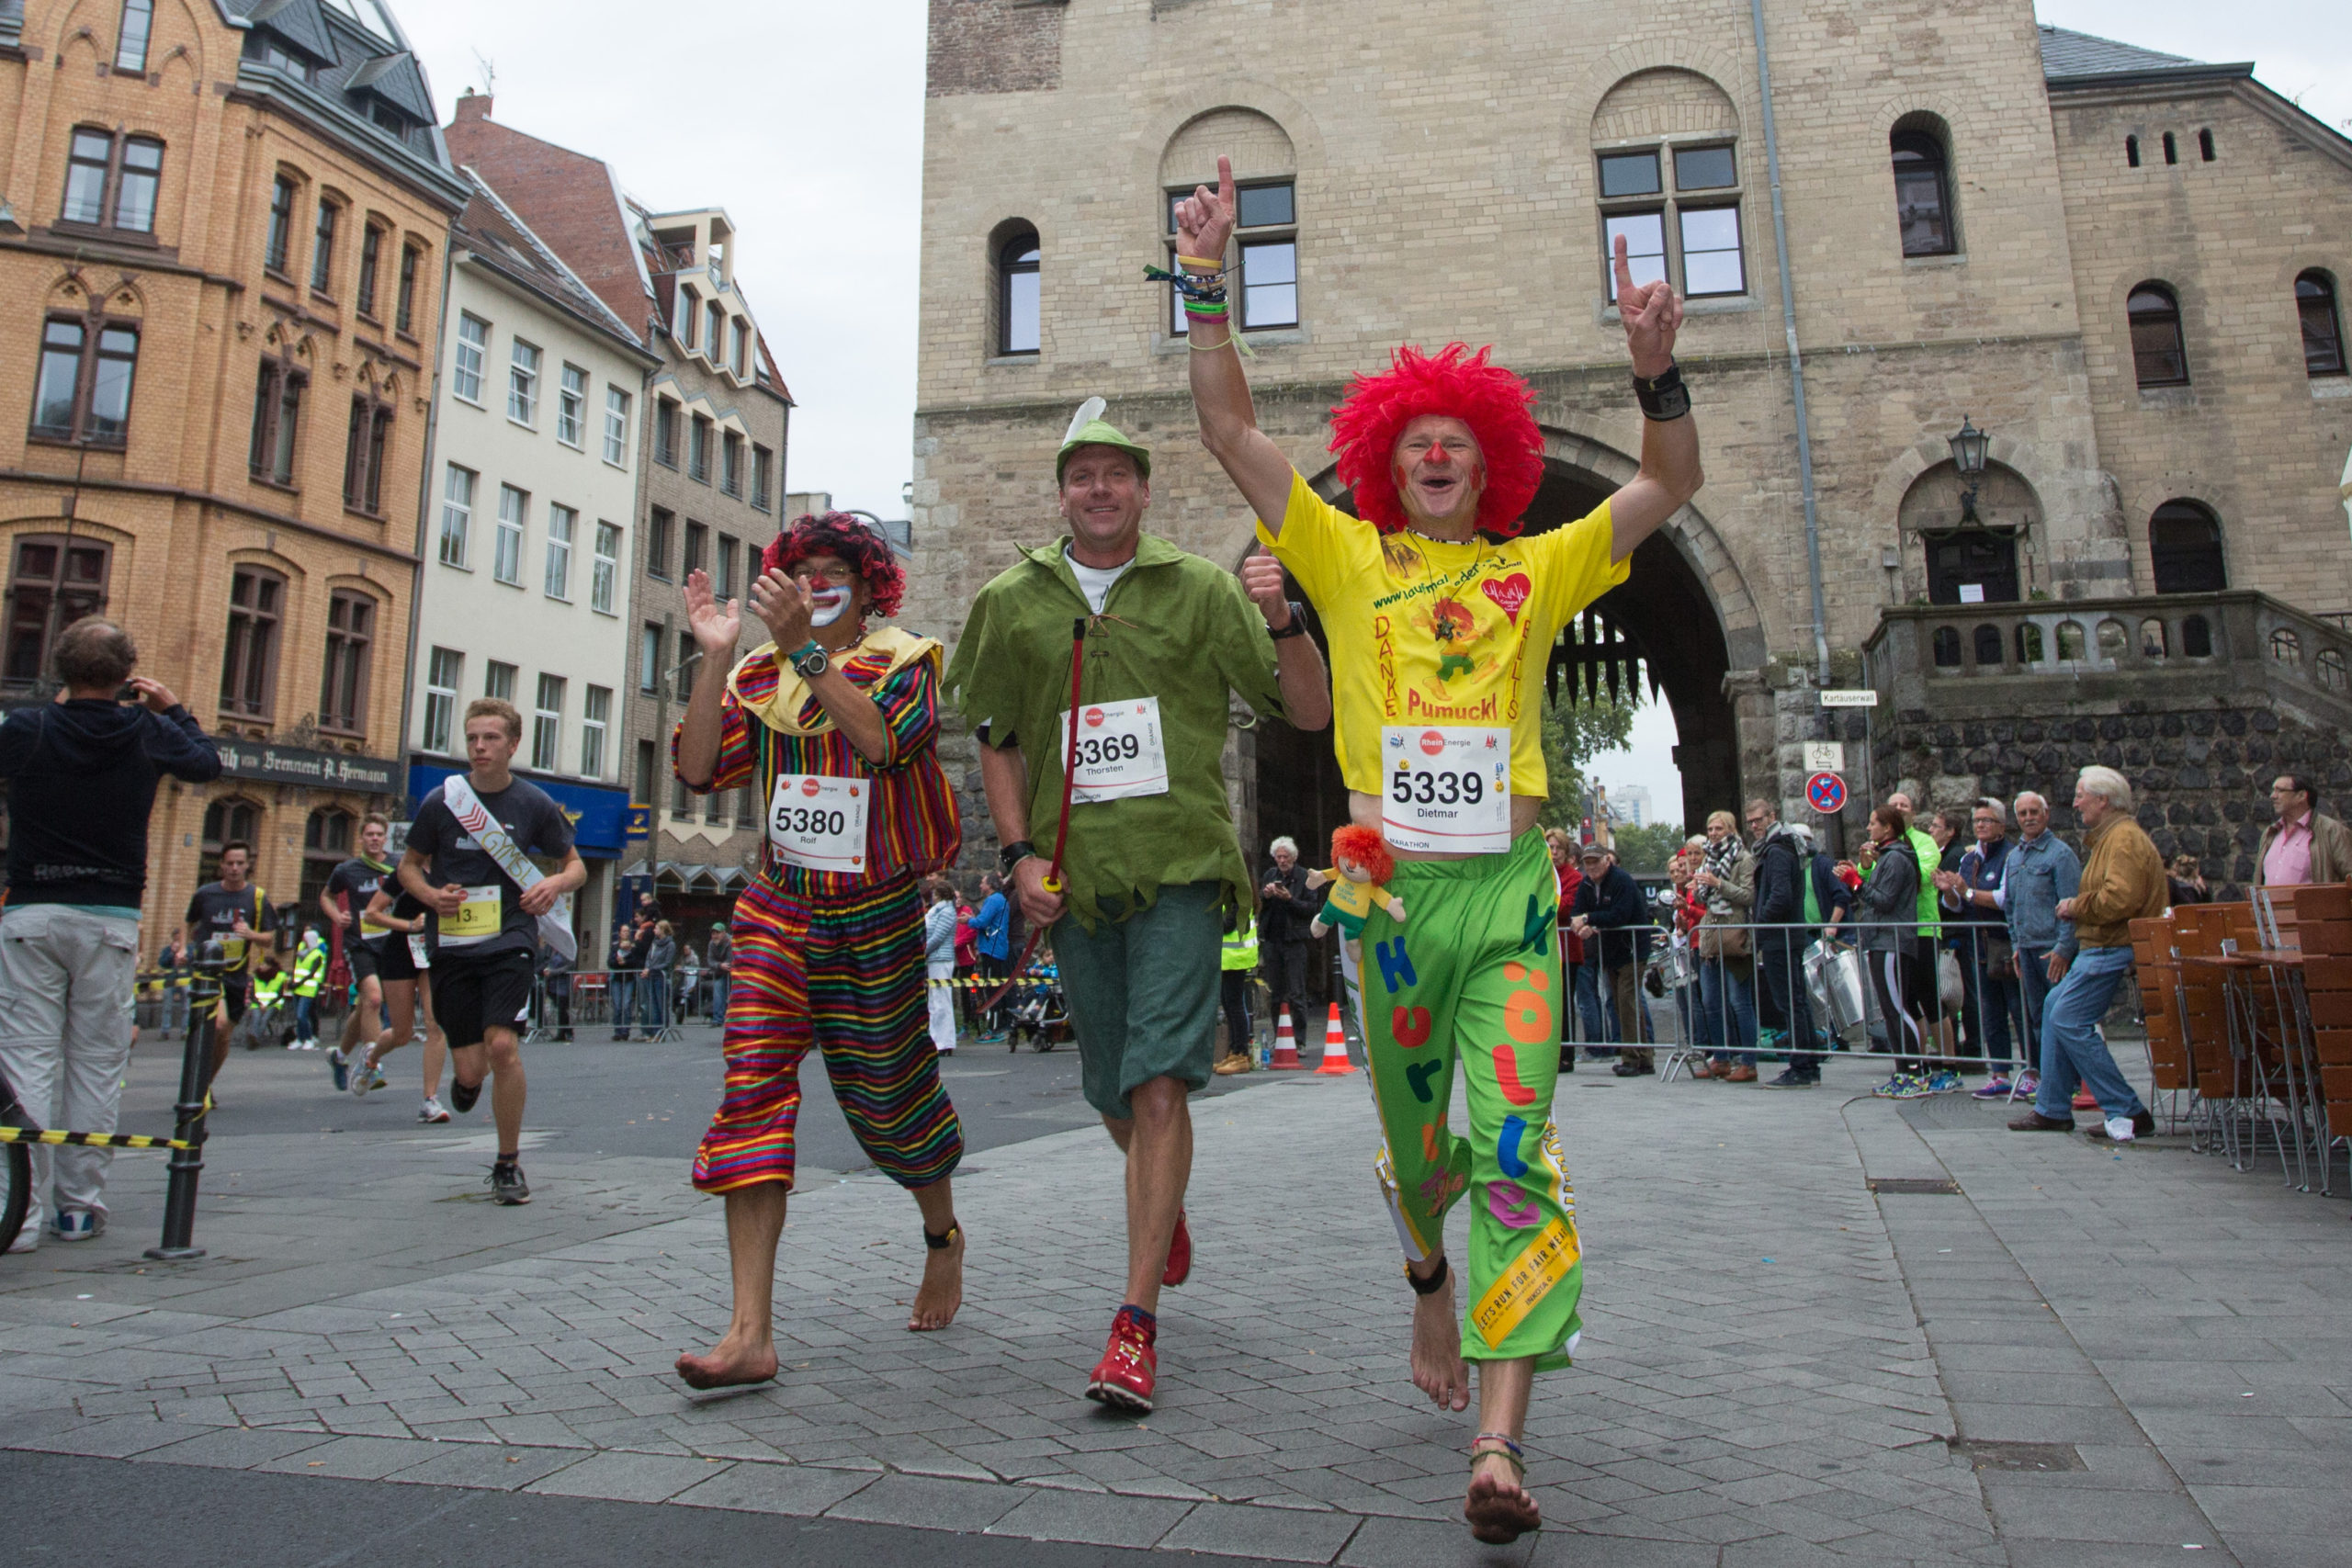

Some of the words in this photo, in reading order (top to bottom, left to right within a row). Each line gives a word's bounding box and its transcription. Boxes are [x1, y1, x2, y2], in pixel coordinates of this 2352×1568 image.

[1374, 615, 1396, 717] DANKE
[1507, 619, 1531, 720] ELLIS
[1408, 687, 1498, 721] Pumuckl
[1824, 694, 1875, 703] Kartäuserwall
[1421, 739, 1471, 748] RheinEnergie
[262, 750, 321, 775] Brennerei
[1086, 765, 1124, 776] Thorsten
[1392, 771, 1483, 805] 5339
[775, 807, 844, 836] 5380
[1418, 808, 1458, 818] Dietmar
[800, 836, 817, 844] Rolf
[1389, 838, 1430, 849] MARATHON
[1645, 886, 1656, 897] U
[1478, 1305, 1496, 1330] LET'S
[1494, 1289, 1512, 1309] RUN
[1511, 1271, 1529, 1290] FOR
[1529, 1250, 1549, 1271] FAIR
[1524, 1281, 1548, 1306] INKOTA
